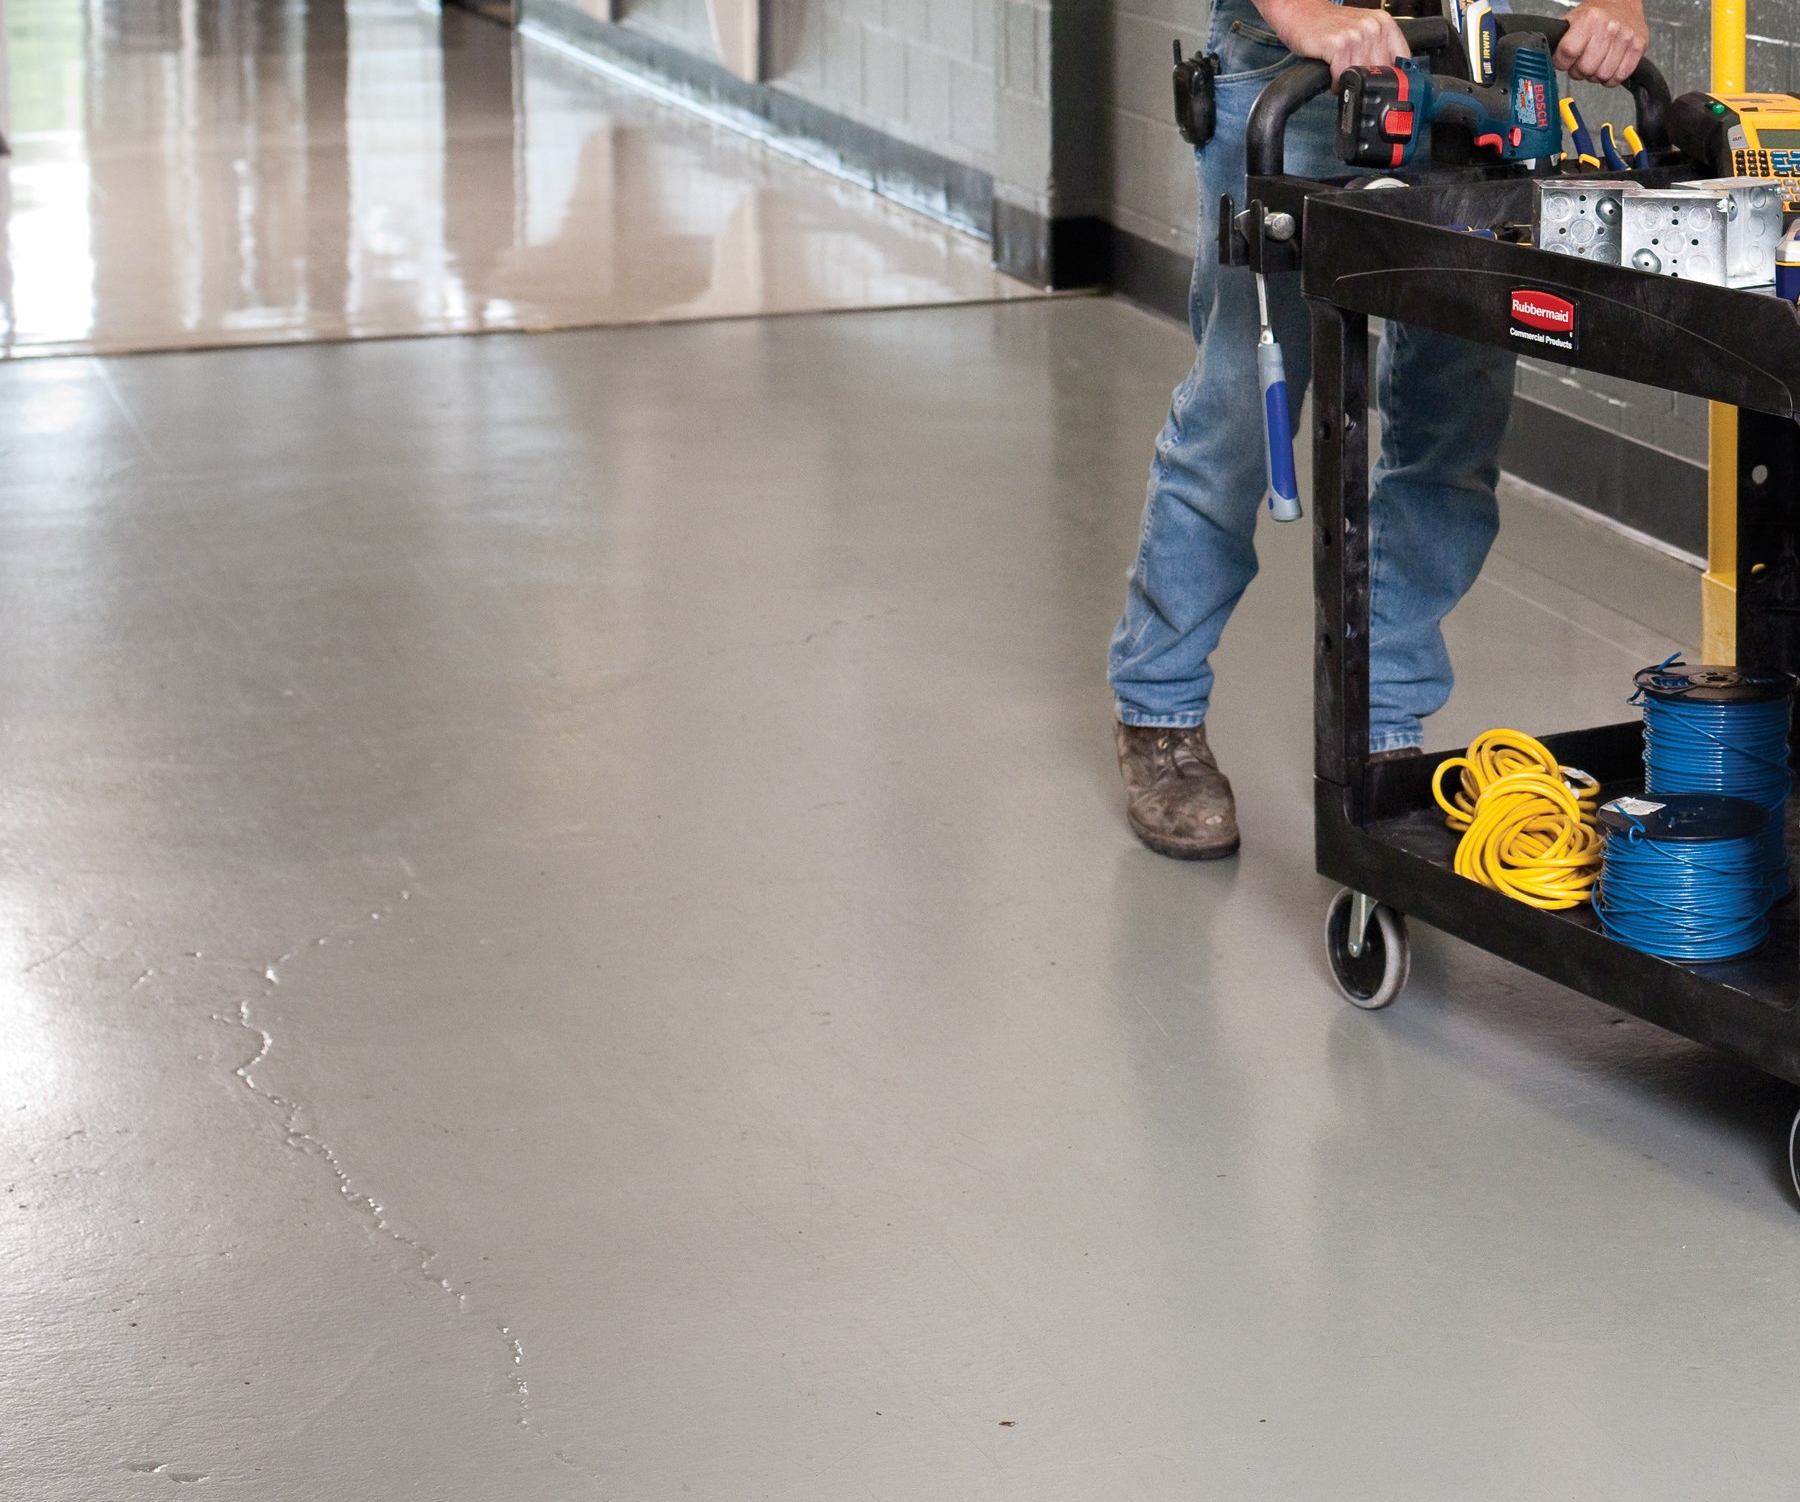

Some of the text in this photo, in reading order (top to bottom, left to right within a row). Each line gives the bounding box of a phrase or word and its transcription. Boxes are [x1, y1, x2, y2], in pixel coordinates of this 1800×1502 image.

[1482, 30, 1491, 59] IRWIN
[1534, 84, 1548, 128] BOSCH
[1512, 299, 1569, 323] Rubbermaid
[1509, 327, 1573, 349] Commercial Products
